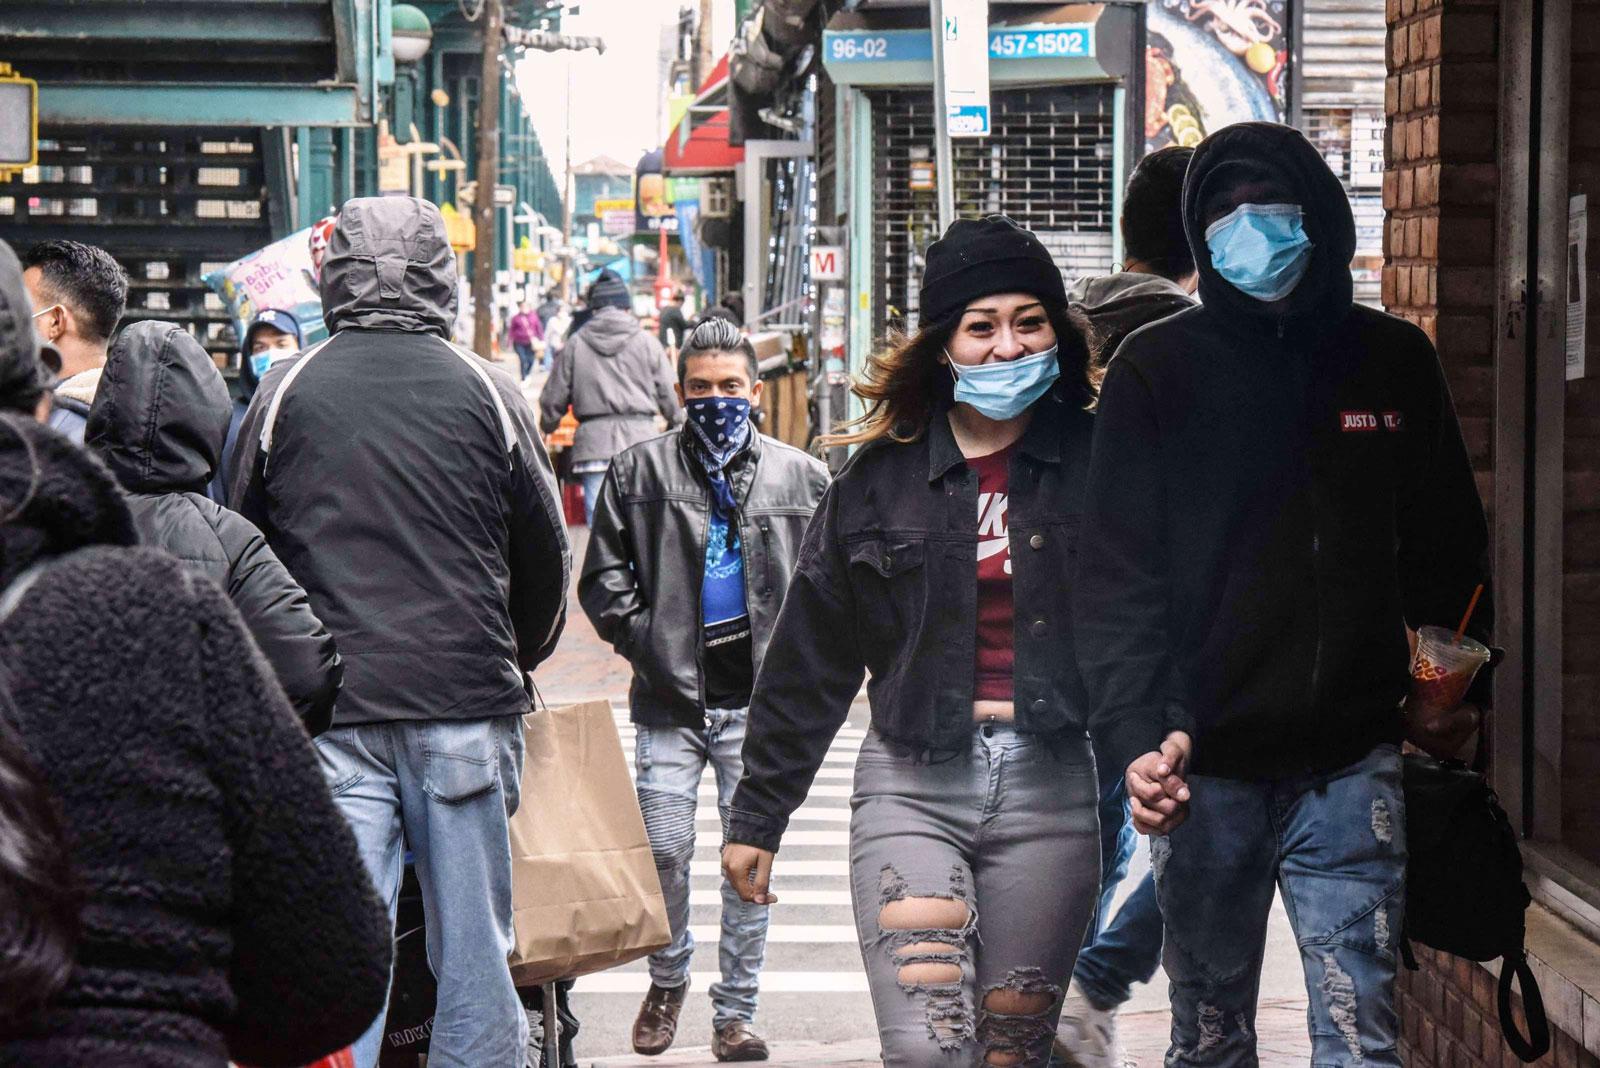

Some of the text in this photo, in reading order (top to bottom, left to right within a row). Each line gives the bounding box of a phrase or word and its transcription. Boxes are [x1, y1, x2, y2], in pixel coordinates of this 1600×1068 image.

[832, 37, 887, 58] 96-02
[990, 32, 1083, 55] 457-1502
[815, 252, 835, 273] M
[1344, 414, 1367, 428] JUST
